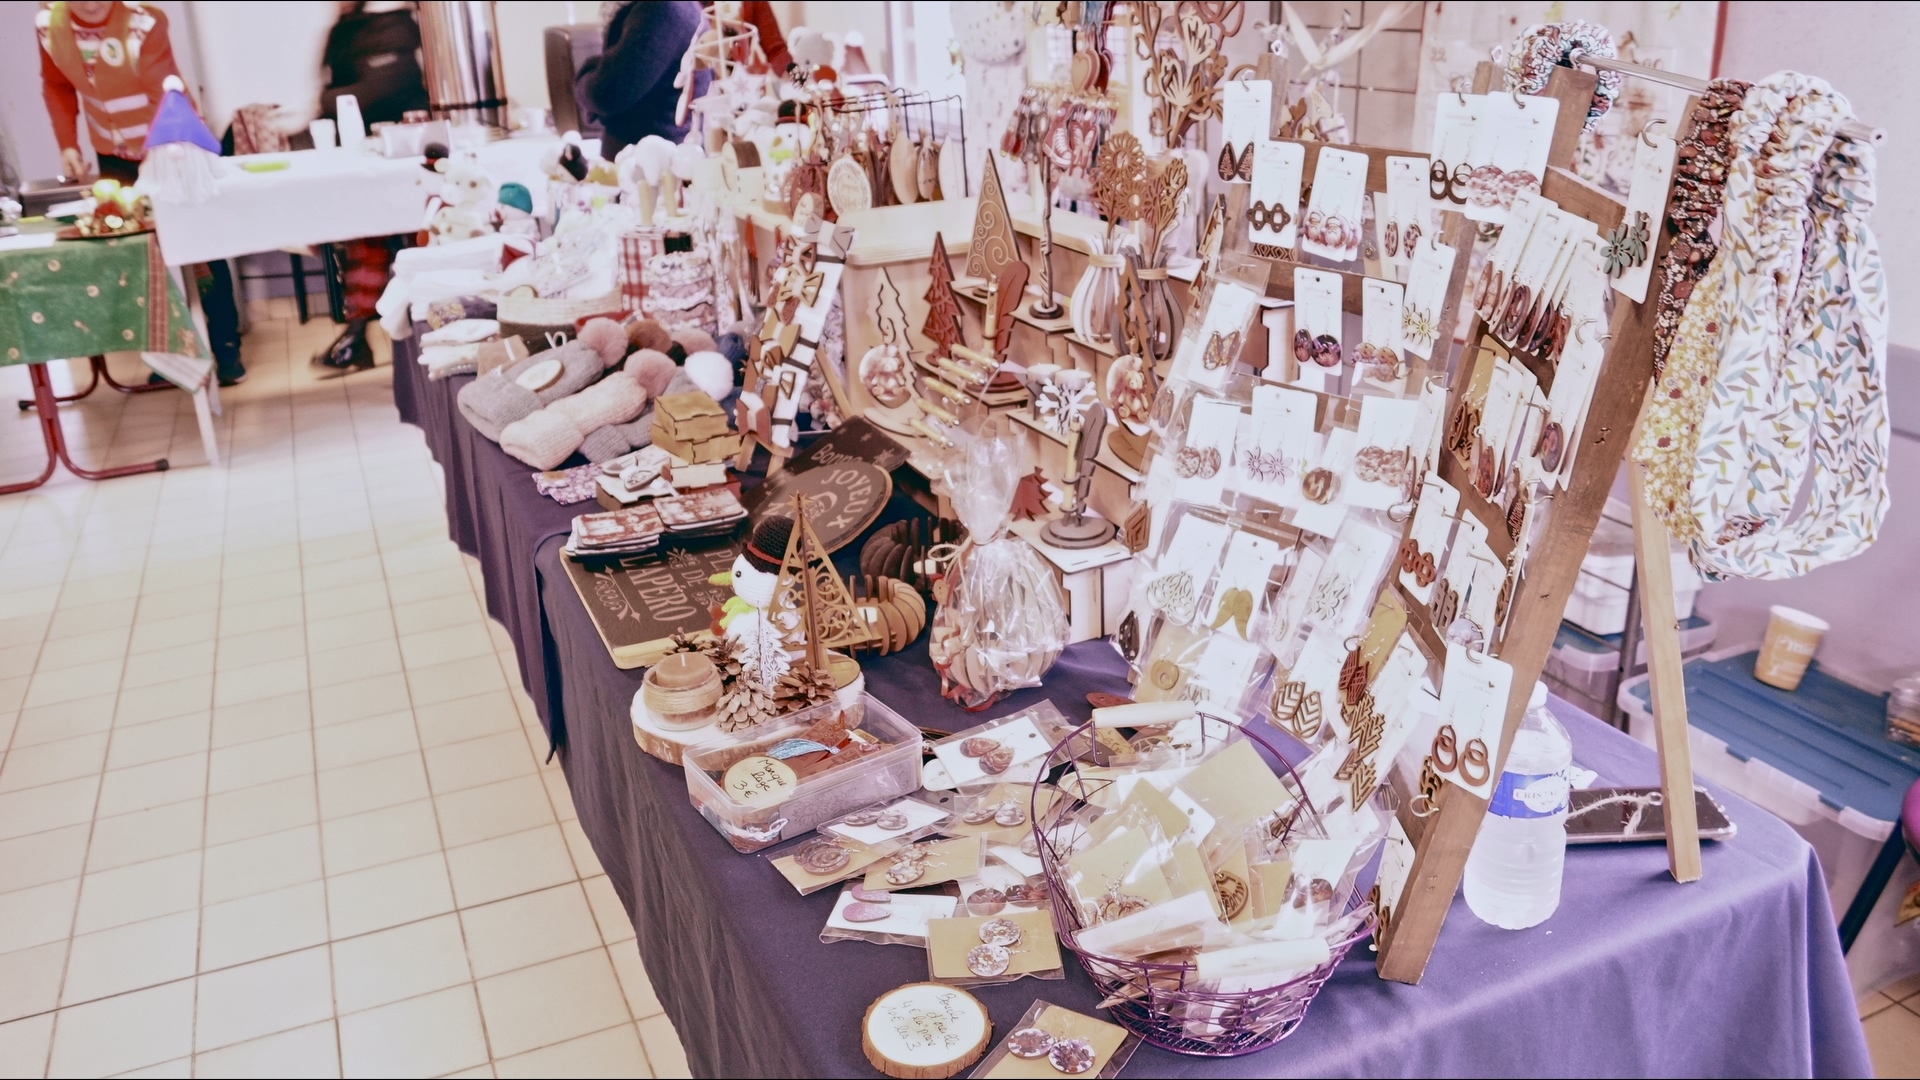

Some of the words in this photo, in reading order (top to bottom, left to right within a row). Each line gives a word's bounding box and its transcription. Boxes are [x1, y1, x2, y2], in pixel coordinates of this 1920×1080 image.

[820, 468, 872, 529] JOYEUX
[619, 552, 698, 622] L'APÉRO
[681, 568, 709, 588] DE
[757, 759, 788, 787] Marque
